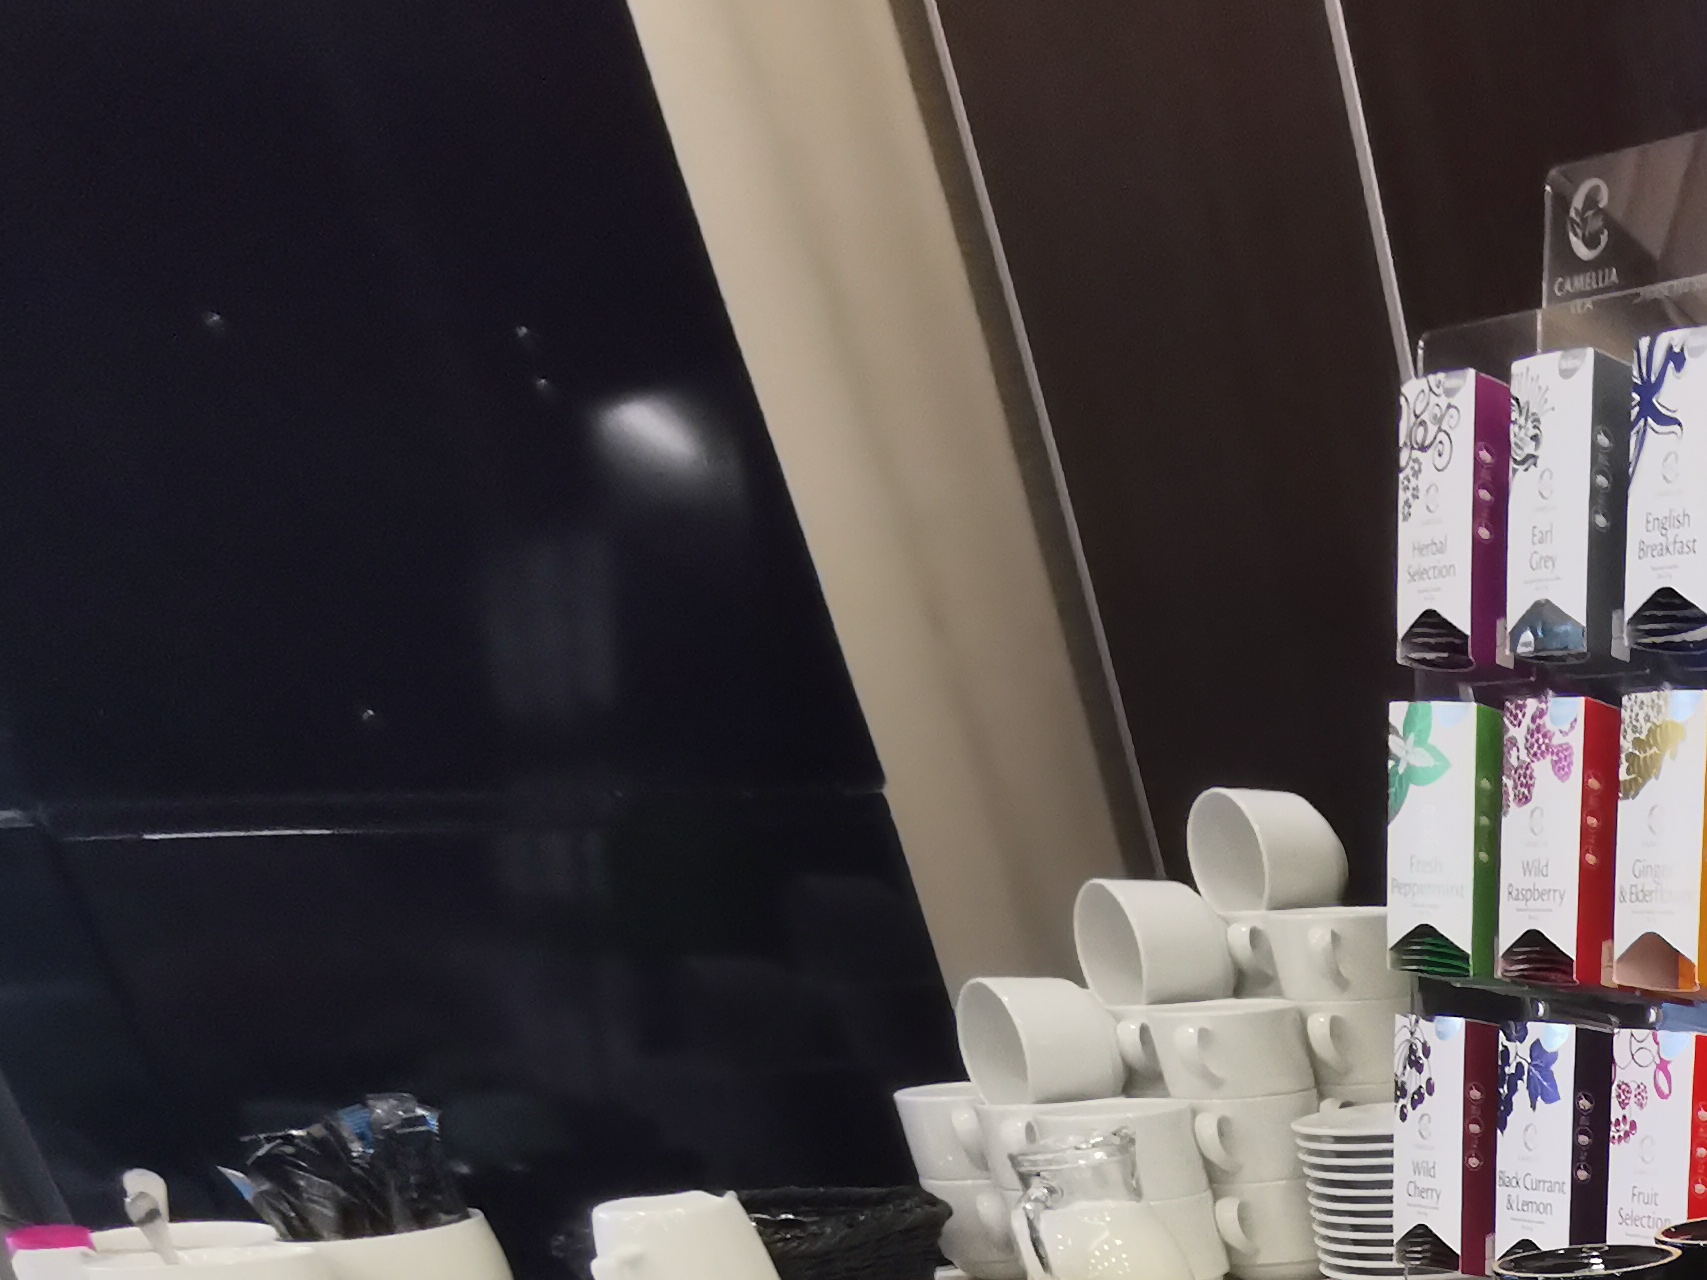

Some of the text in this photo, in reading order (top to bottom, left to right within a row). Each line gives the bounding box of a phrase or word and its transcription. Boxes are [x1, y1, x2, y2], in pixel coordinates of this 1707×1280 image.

[1644, 507, 1691, 537] English
[1411, 533, 1448, 558] Herbal
[1530, 522, 1554, 546] Earl
[1637, 533, 1698, 561] Breakfast
[1528, 550, 1557, 572] Grey
[1406, 563, 1457, 584] Selection
[1409, 854, 1443, 874] Fresh
[1521, 858, 1549, 878] Wild
[1506, 882, 1566, 907] Raspberry
[1412, 1159, 1436, 1179] Wild
[1406, 1180, 1442, 1206] Cherry
[1498, 1170, 1567, 1195] Black Currant
[1506, 1193, 1554, 1216] & Lemon
[1631, 1185, 1660, 1207] Fruit
[1617, 1207, 1672, 1230] Selection
